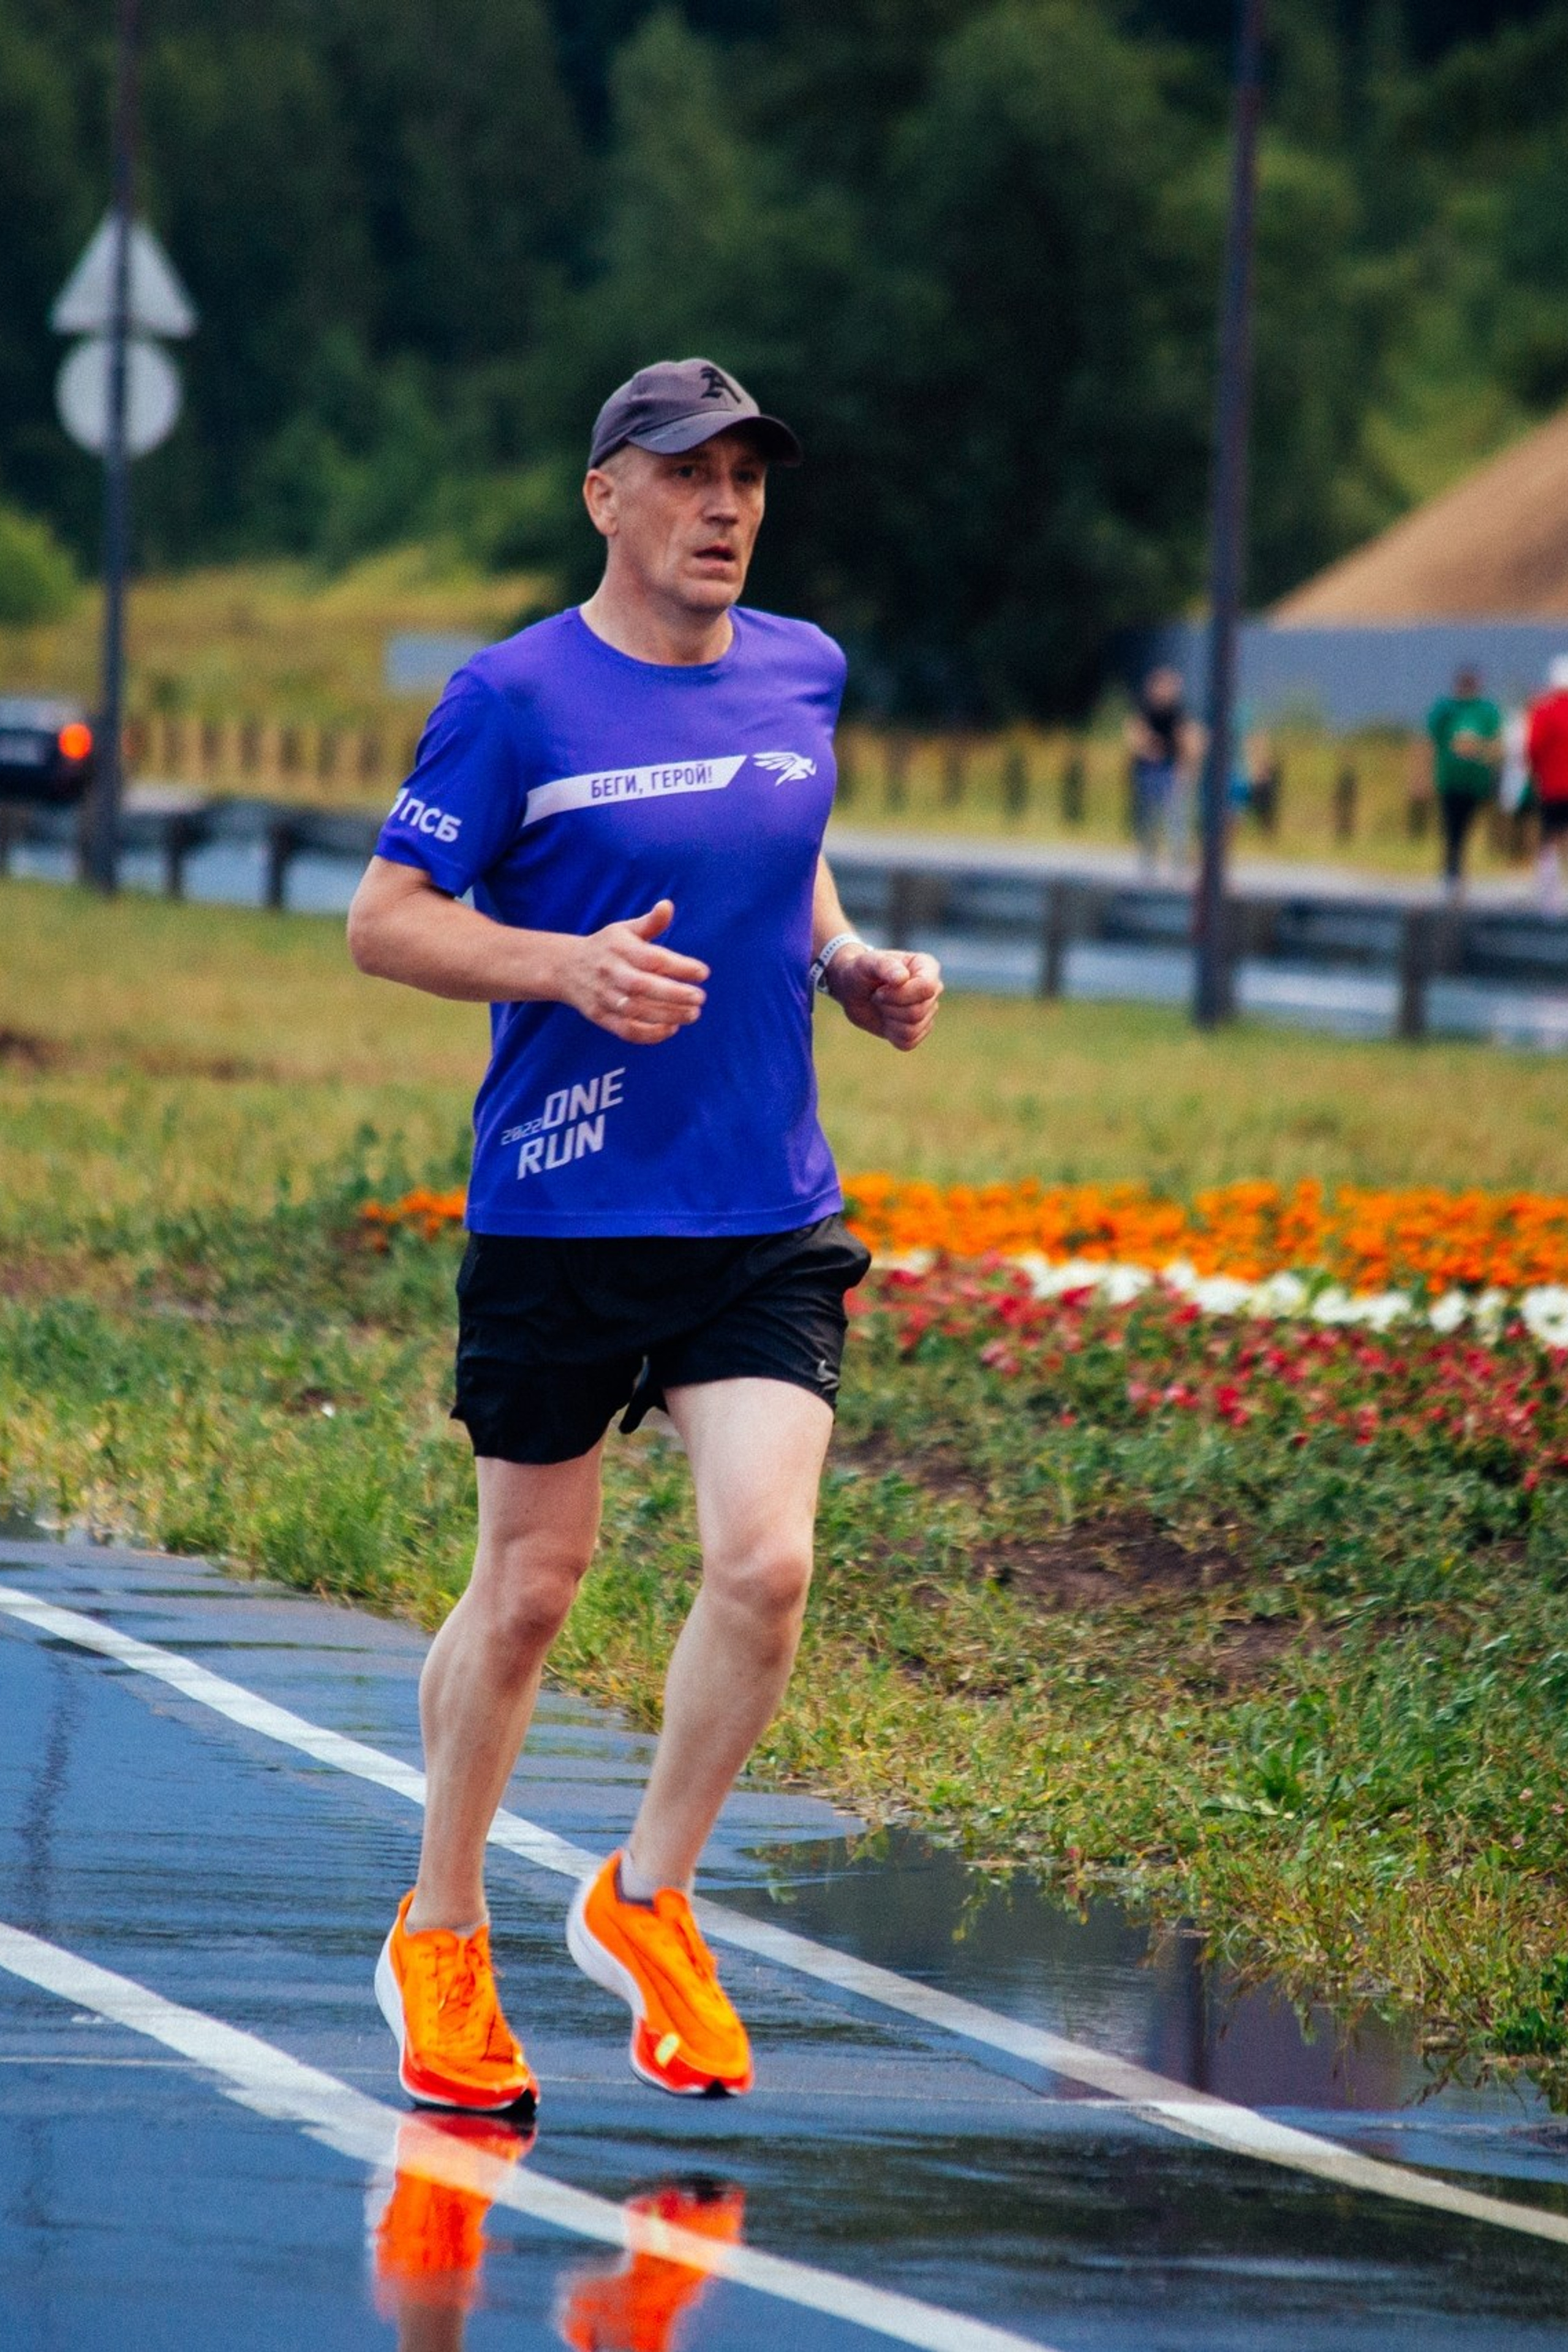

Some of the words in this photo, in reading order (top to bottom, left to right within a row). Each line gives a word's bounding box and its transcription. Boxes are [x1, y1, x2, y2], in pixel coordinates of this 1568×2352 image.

[591, 778, 644, 799] БЕГИ,
[650, 763, 714, 791] ГЕРОЙ!
[399, 797, 462, 842] ПСБ
[541, 1067, 625, 1130] ONE
[517, 1114, 605, 1180] RUN
